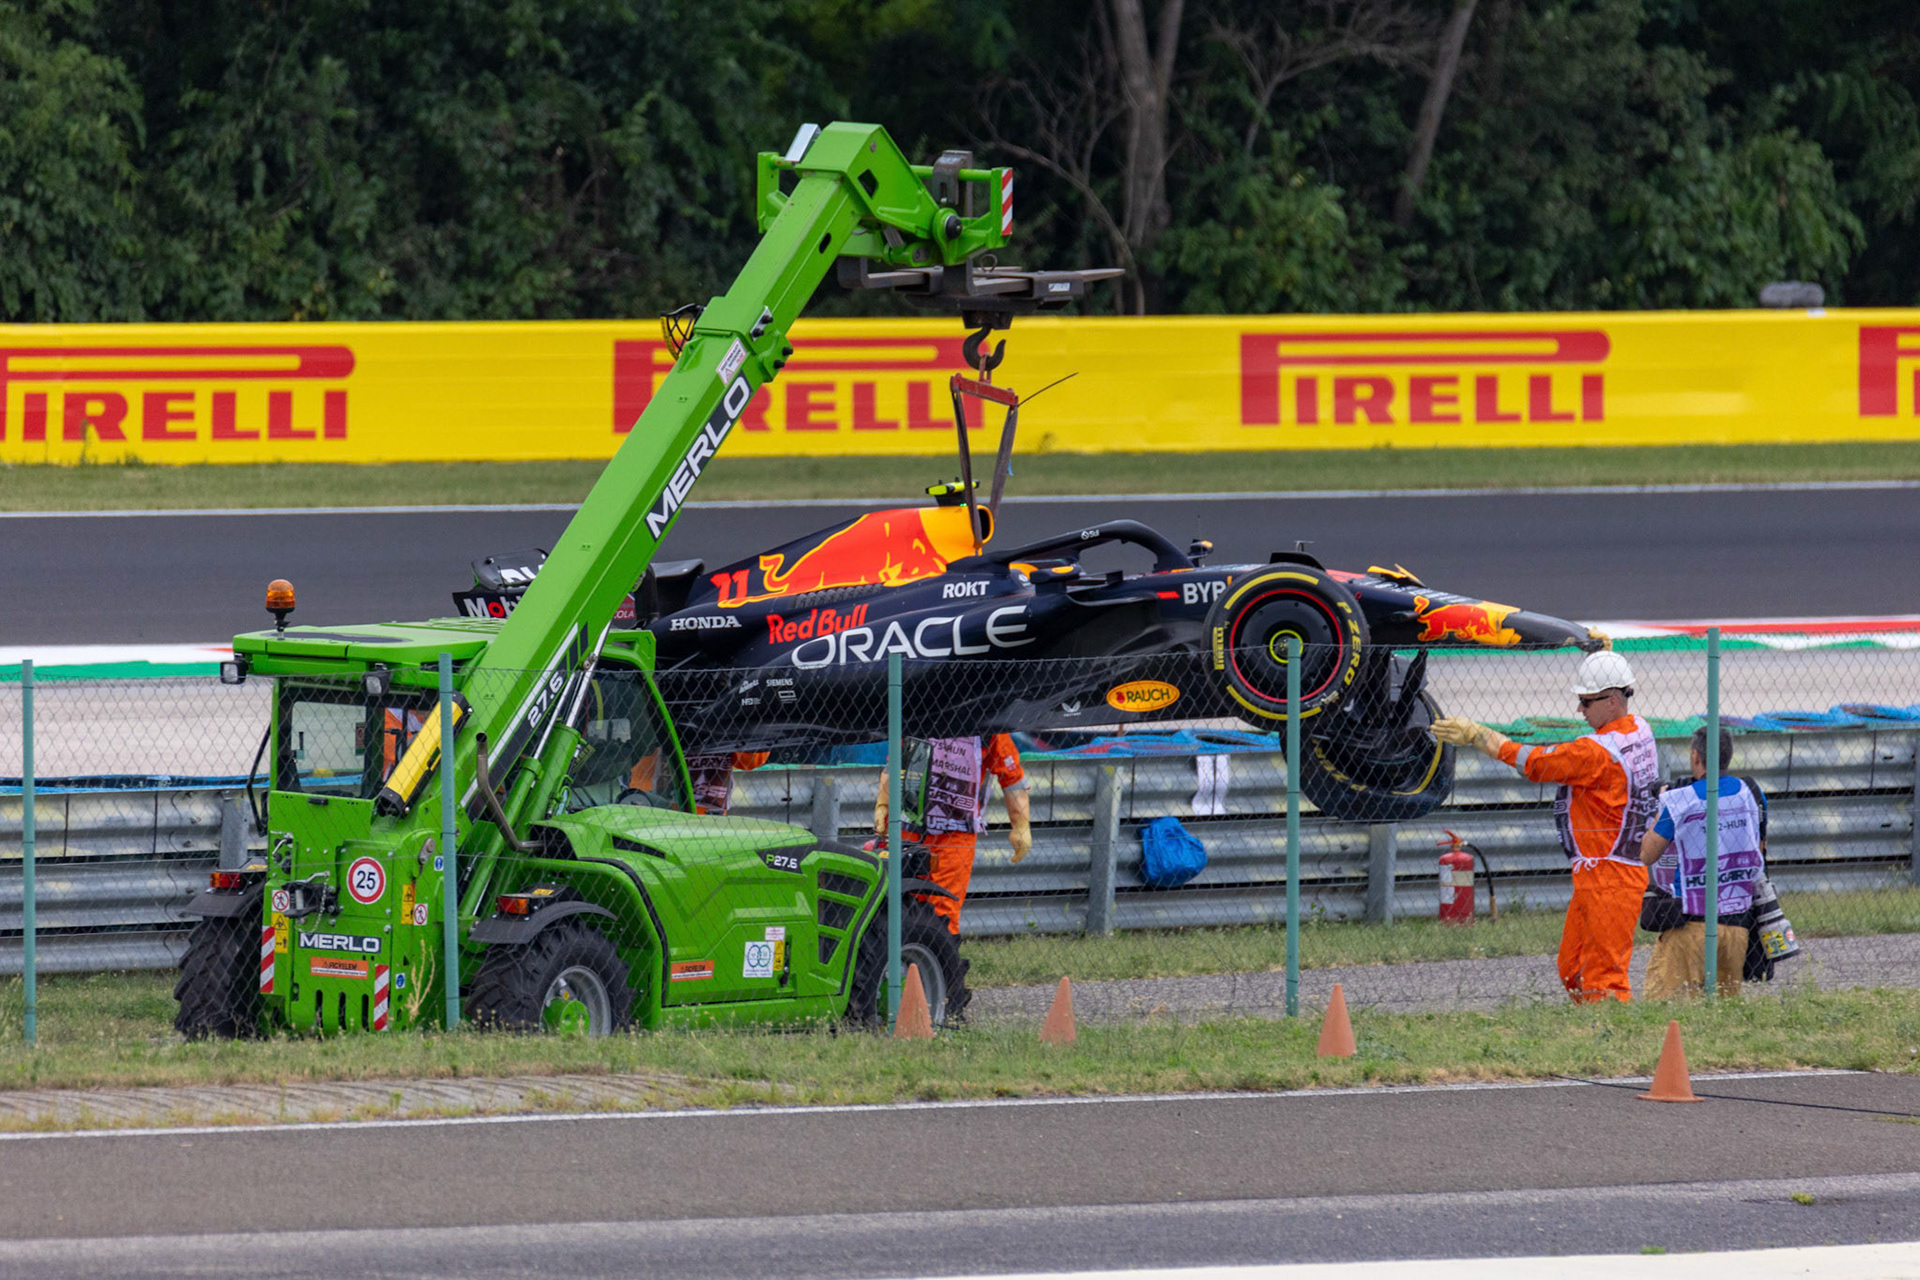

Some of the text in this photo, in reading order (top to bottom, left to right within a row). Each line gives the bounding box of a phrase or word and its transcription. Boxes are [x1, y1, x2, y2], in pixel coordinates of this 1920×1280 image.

[1240, 330, 1612, 425] PIRELLI
[645, 376, 750, 539] MERLO
[710, 569, 750, 601] 11
[942, 580, 989, 599] ROKT
[669, 615, 742, 631] HONDA
[791, 604, 1036, 670] ORACLE
[1337, 601, 1362, 686] P ZERO
[766, 678, 793, 686] SIEMENS
[527, 671, 564, 729] 27.6
[1126, 688, 1170, 702] RAUCH
[766, 854, 798, 870] P27.6
[356, 870, 376, 891] 25
[1685, 868, 1754, 888] HUGARY
[300, 933, 380, 953] MERLO
